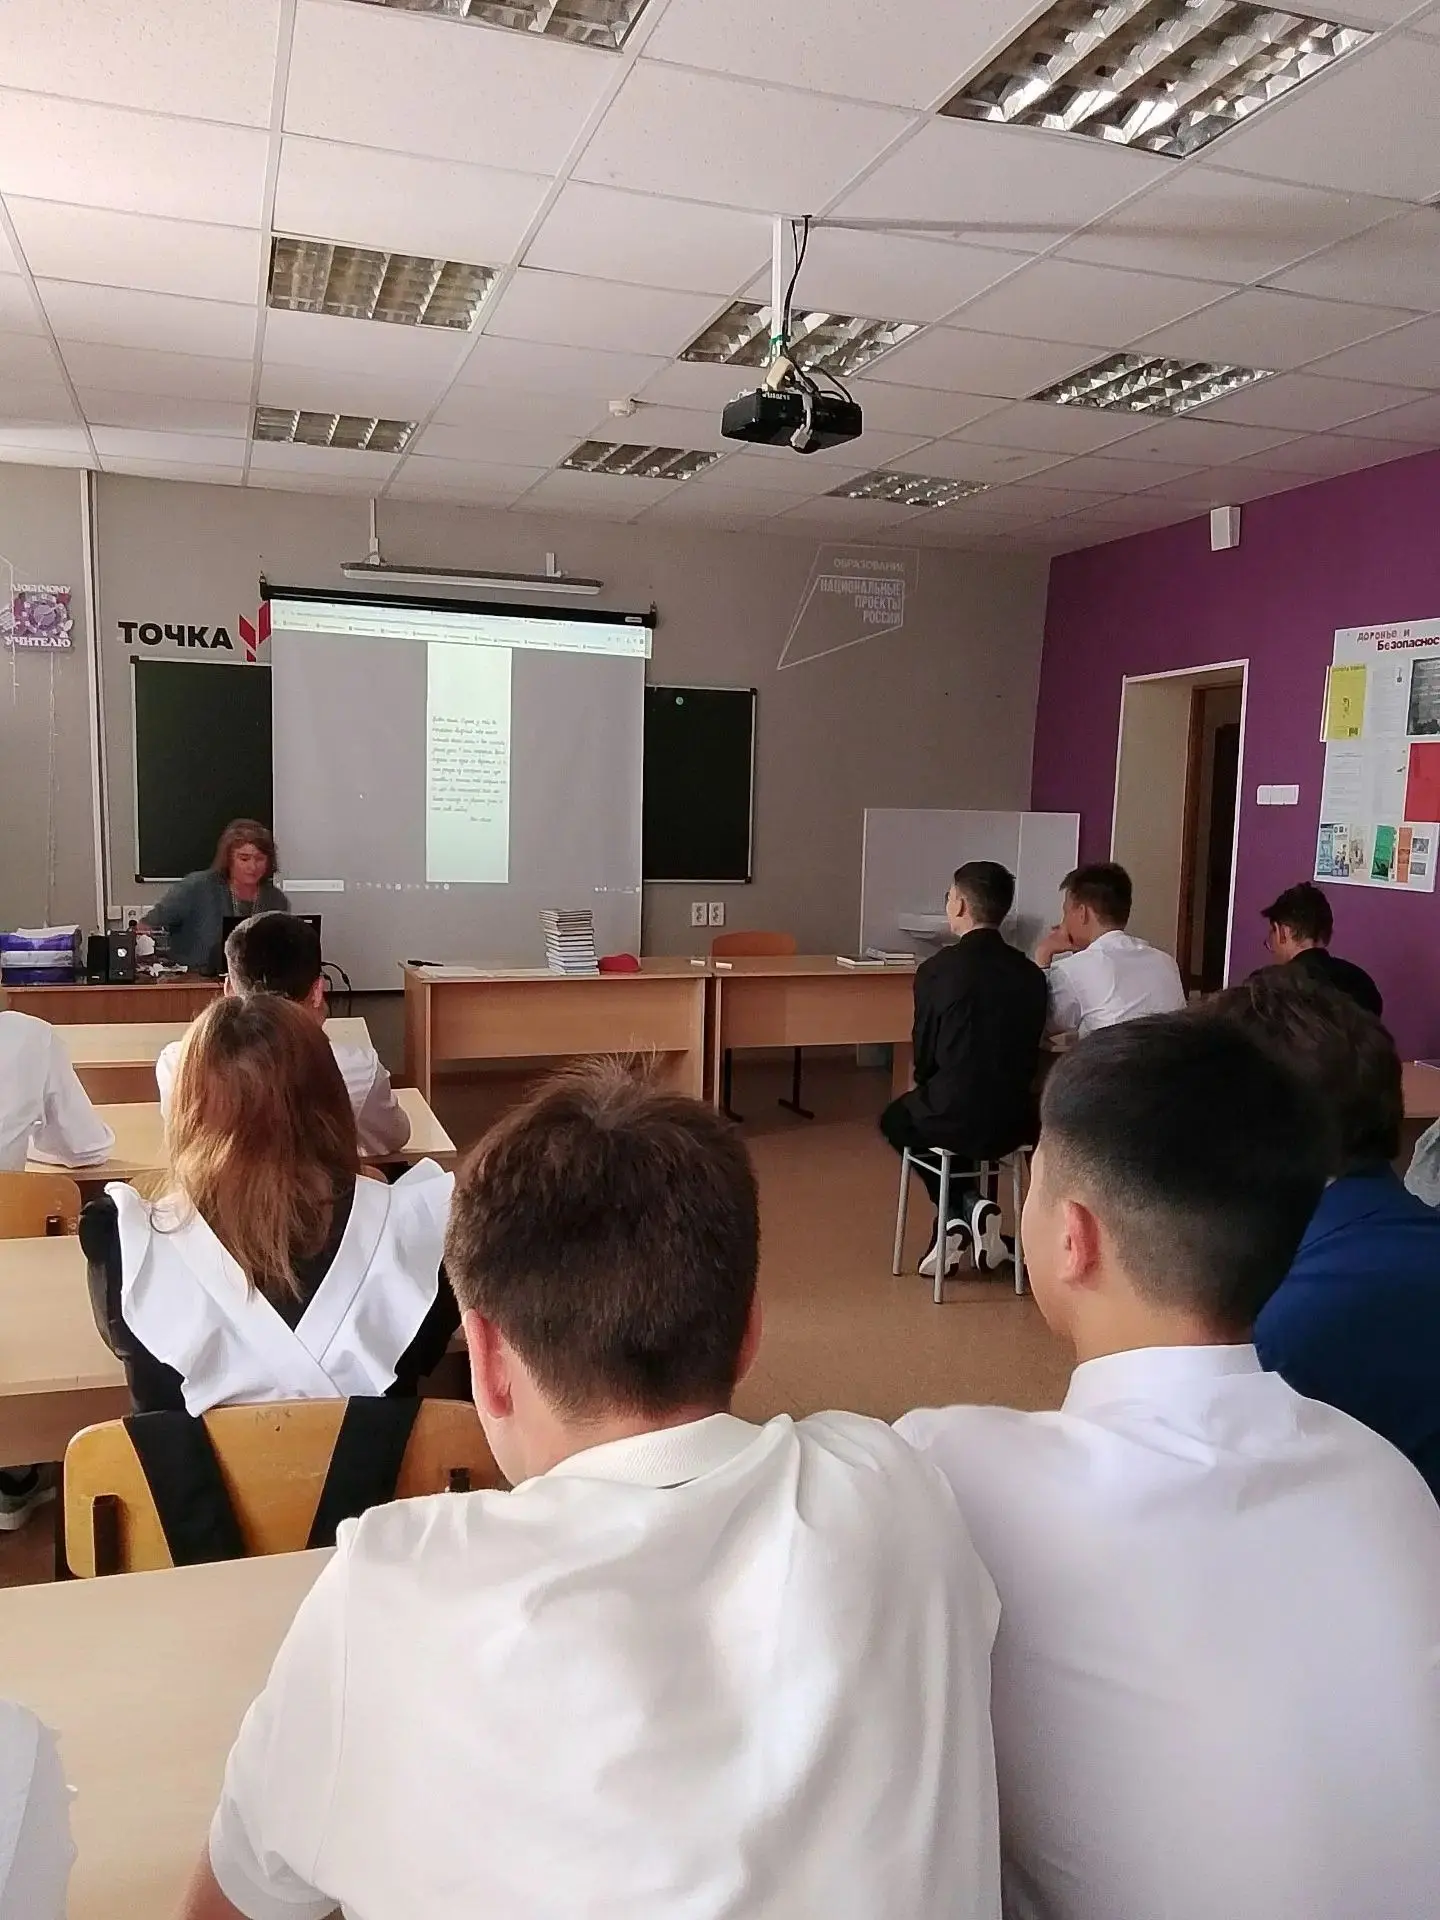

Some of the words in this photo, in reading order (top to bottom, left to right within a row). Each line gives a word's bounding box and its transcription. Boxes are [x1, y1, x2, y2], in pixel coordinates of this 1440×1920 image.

[855, 595, 901, 610] ПРОЕКТЫ
[863, 610, 901, 624] РОССИИ
[4, 636, 72, 647] УЧИТЕЛЮ
[117, 621, 234, 650] ТОЧКА
